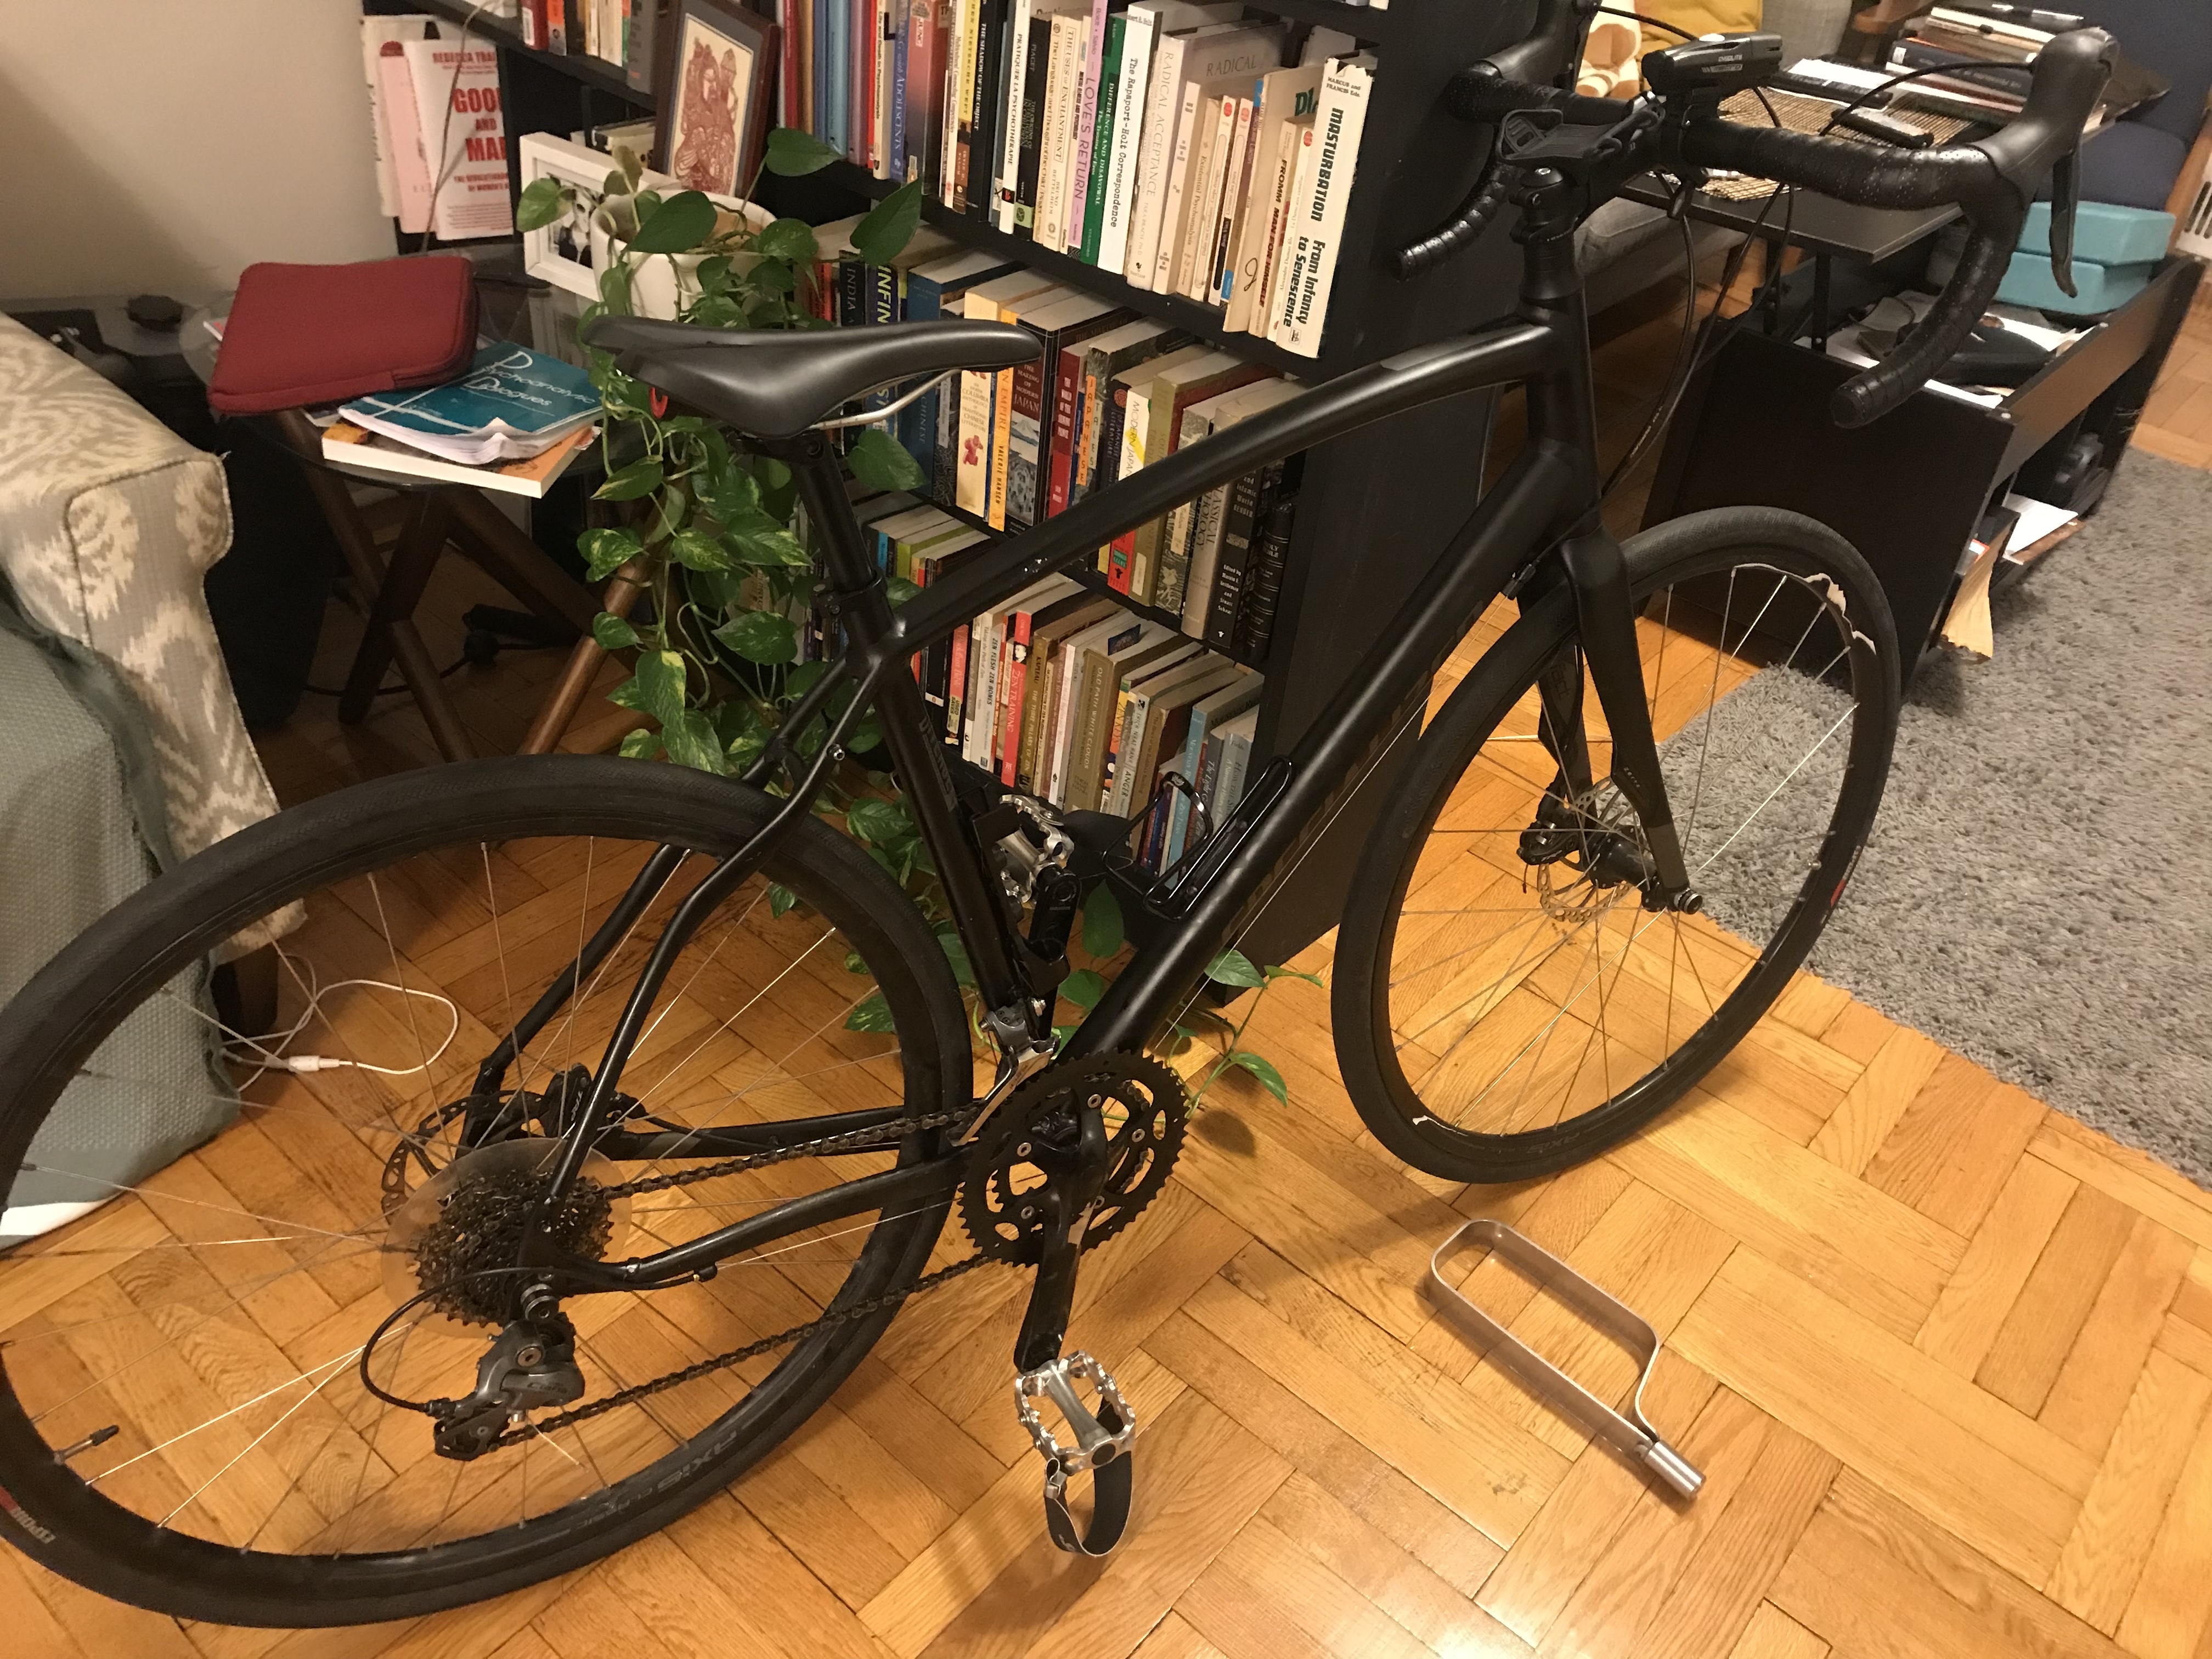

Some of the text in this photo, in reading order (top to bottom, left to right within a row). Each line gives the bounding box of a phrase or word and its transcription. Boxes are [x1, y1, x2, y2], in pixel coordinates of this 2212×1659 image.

[1011, 33, 1023, 82] PRATIQUER
[1063, 48, 1071, 76] USES
[1206, 55, 1257, 77] RADICAL
[1011, 83, 1019, 93] LA
[1157, 52, 1174, 109] RADICAL
[1325, 82, 1349, 94] FRANCIS
[1327, 76, 1350, 88] MARCUS
[476, 118, 498, 131] AND
[894, 77, 905, 150] ADOLESCENTS
[1055, 85, 1068, 161] ENCHANTMENT
[1081, 77, 1096, 136] LOVE'S
[1103, 83, 1114, 137] DIFFERENCE
[1110, 58, 1138, 228] The Rapaport-Holt Correspondence
[1146, 115, 1165, 197] ACCEPTANCE
[1311, 108, 1344, 222] MASTURBATION
[1074, 139, 1089, 200] RETURN
[1095, 159, 1105, 206] DISAVOWAL
[1188, 155, 1207, 245] Existential Psychoanalysis
[1259, 159, 1288, 308] FROMM MAN FOR HIMSELF
[847, 267, 856, 311] INDIA
[877, 264, 893, 324] INFIN
[1284, 236, 1310, 328] to Senescence
[1295, 240, 1325, 325] From Infancy
[464, 376, 552, 407] Dialogues
[962, 388, 988, 403] COLUMBIA
[1016, 386, 1040, 399] MODERN
[1017, 370, 1040, 383] MAKING
[997, 387, 1009, 432] EMPIRE
[1014, 393, 1040, 413] JAPAN
[1128, 400, 1141, 448] MODERN
[1080, 379, 1094, 482] JAPANESE
[1089, 402, 1100, 466] TALES
[1114, 421, 1122, 458] JAPANESE
[1233, 504, 1253, 518] READER
[1236, 483, 1257, 497] Islamic
[1237, 495, 1254, 507] World
[1206, 486, 1223, 544] LASSICAL
[1223, 564, 1236, 574] Edited
[1007, 669, 1021, 732] ZEN TRAINING
[1025, 748, 1031, 758] OF
[1026, 721, 1035, 747] PILLARS
[1084, 737, 1093, 770] CLOUDS
[1121, 771, 1131, 797] ANGER
[1204, 772, 1214, 790] Eight
